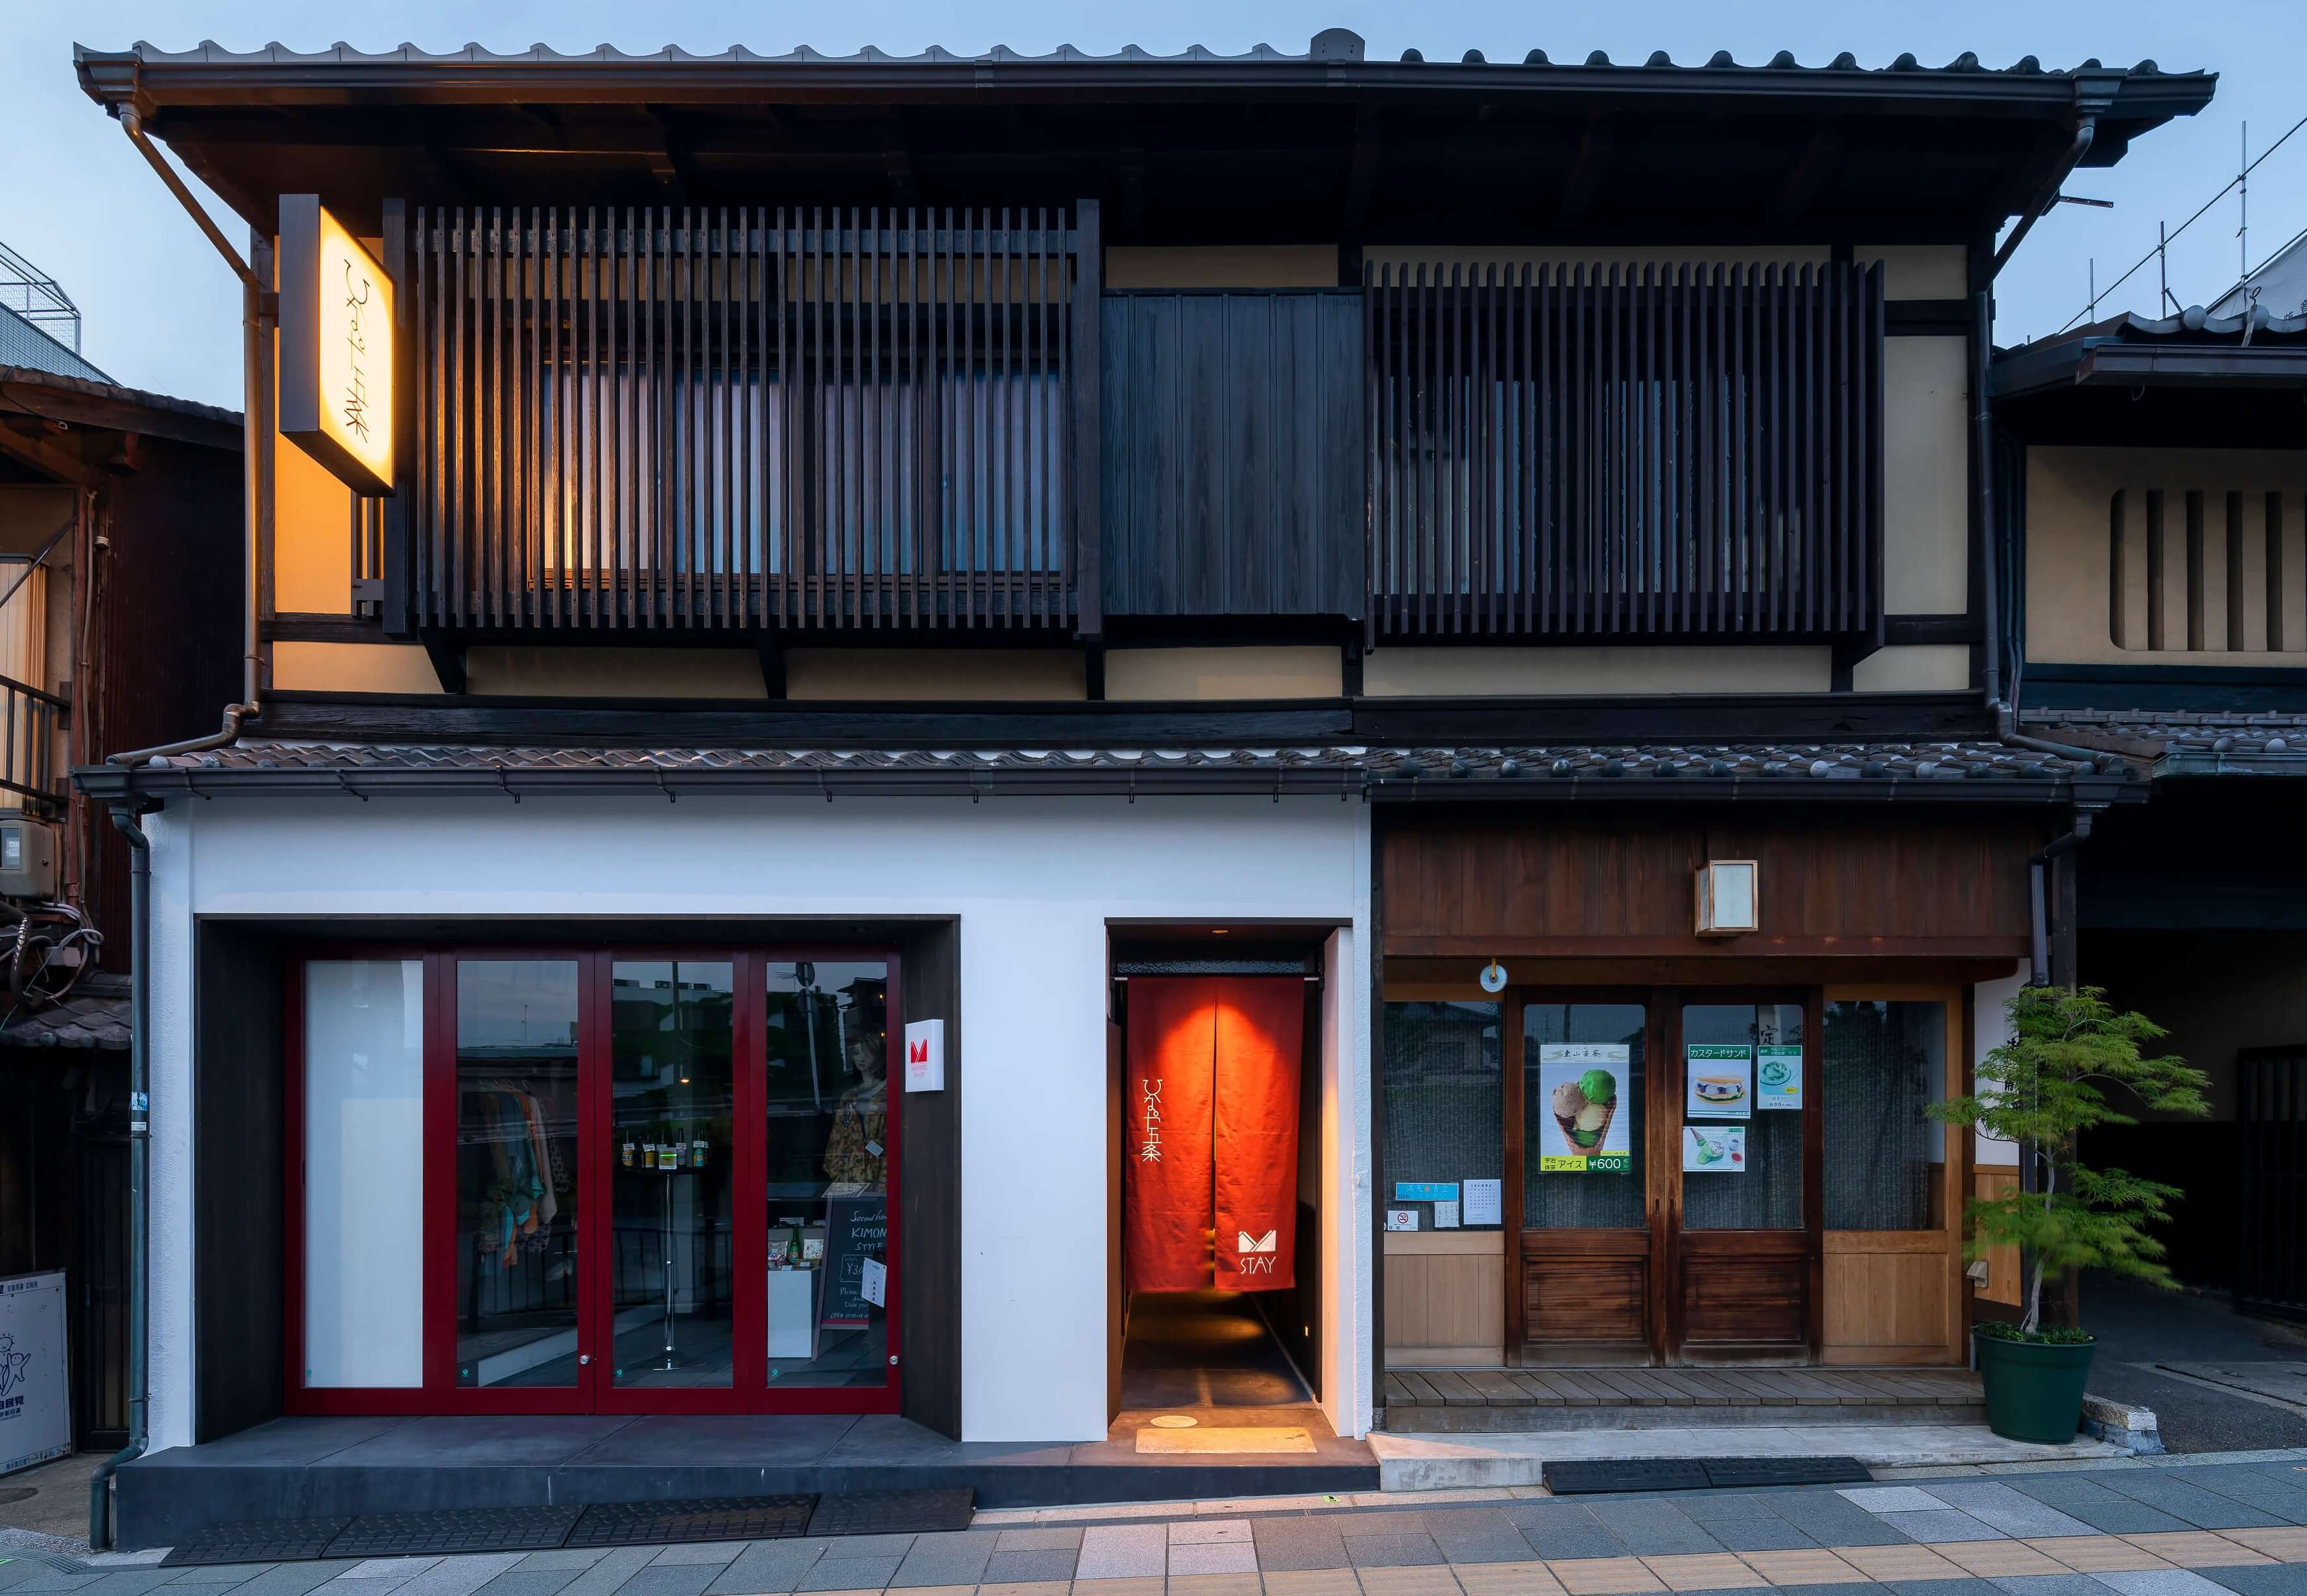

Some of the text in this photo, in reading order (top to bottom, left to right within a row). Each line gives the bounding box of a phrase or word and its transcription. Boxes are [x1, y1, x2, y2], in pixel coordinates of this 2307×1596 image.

[1691, 1049, 1746, 1058] カスタードサンド
[1558, 1160, 1583, 1169] アイス
[1588, 1158, 1621, 1169] ¥600
[850, 1209, 887, 1222] Second han
[852, 1228, 887, 1239] KIMON
[1240, 1256, 1276, 1275] STAY
